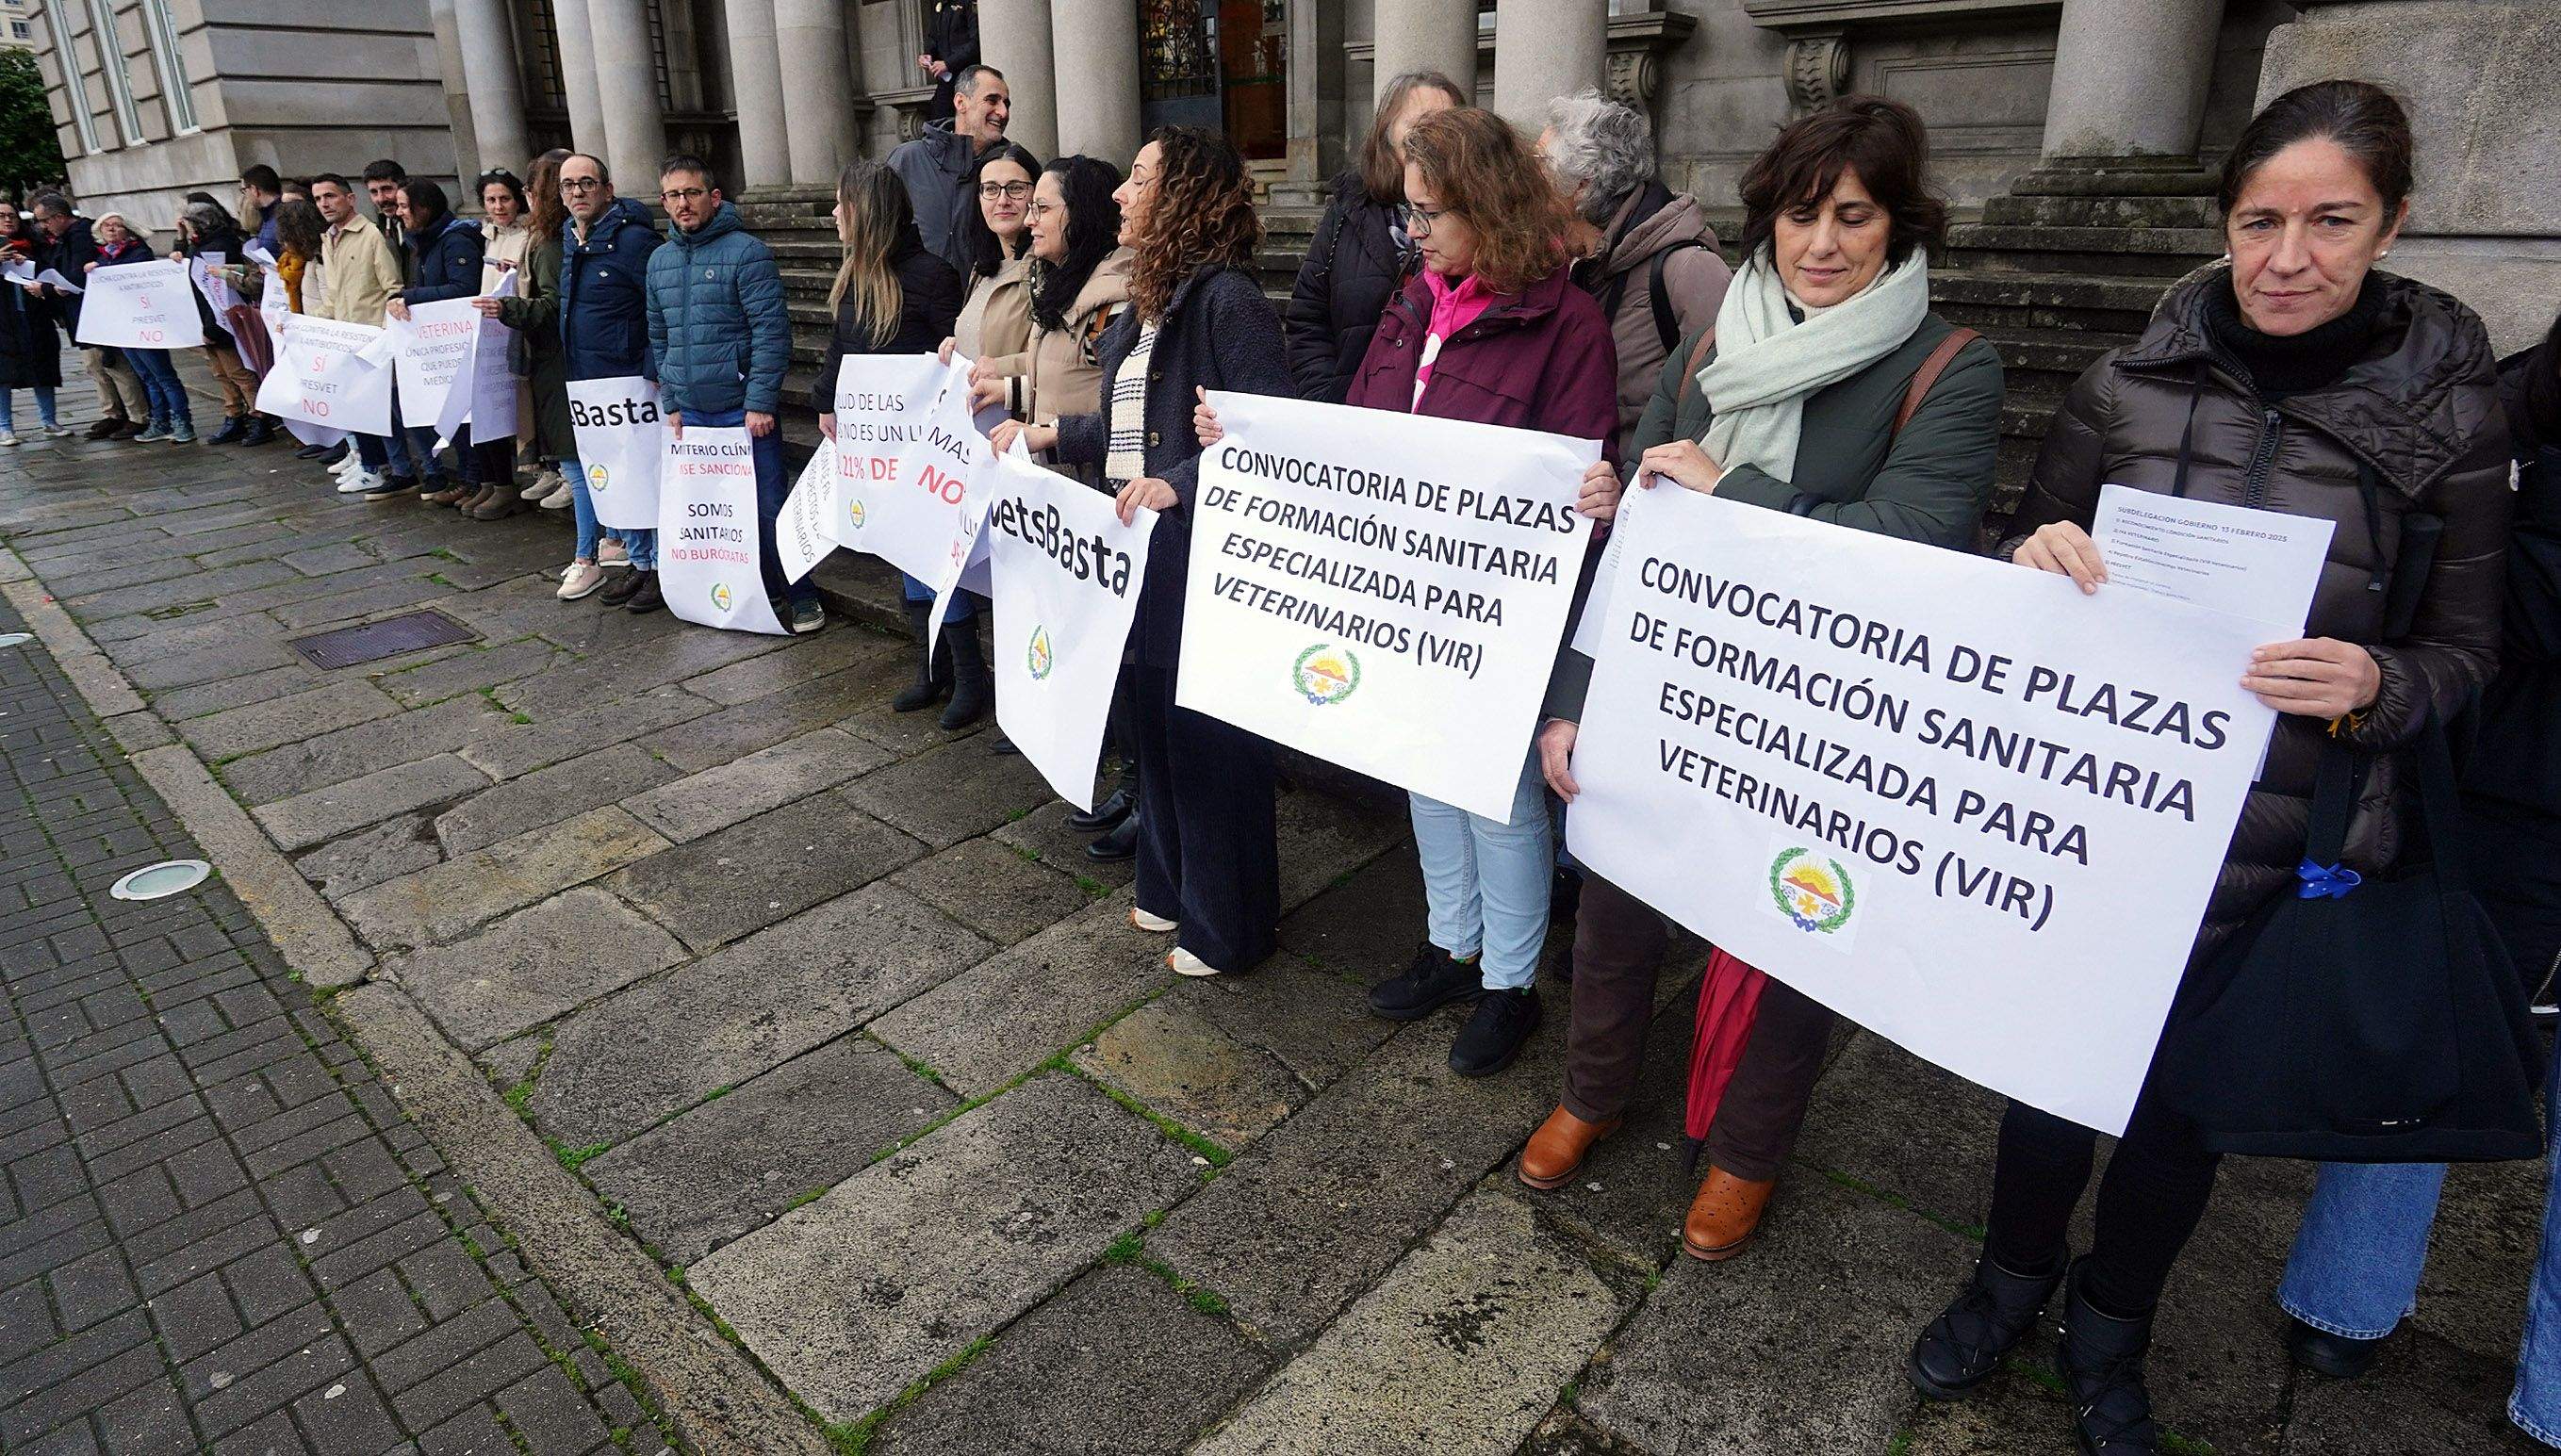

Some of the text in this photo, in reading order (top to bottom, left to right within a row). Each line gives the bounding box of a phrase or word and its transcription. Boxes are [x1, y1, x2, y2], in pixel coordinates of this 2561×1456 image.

[140, 330, 164, 342] NO
[303, 399, 329, 417] NO
[859, 393, 873, 411] DE
[878, 394, 904, 412] LAS
[861, 424, 874, 441] ES
[878, 425, 903, 442] UN
[843, 455, 865, 480] 21%
[870, 457, 899, 481] DE
[917, 465, 966, 506] NO
[1223, 448, 1405, 505] CONVOCATORIA
[1416, 482, 1450, 512] DE
[1457, 489, 1576, 533] PLAZAS
[688, 503, 733, 517] SOMOS
[680, 526, 743, 543] SANITARIOS
[1205, 486, 1556, 584] DE FORMACIÓN SANITARIA
[2177, 517, 2218, 532] GOBIERNO
[2222, 525, 2230, 533] 13
[2231, 527, 2267, 540] FEBRERO
[2267, 532, 2289, 543] 2025
[671, 548, 687, 560] NO
[1222, 530, 1501, 626] ESPECIALIZADA PARA
[1215, 573, 1482, 679] VETERINARIOS (VIR)
[1642, 557, 2230, 749] CONVOCATORIA DE PLAZAS
[1631, 612, 2193, 824] DE FORMACIÓN SANITARIA
[1660, 679, 2087, 865] ESPECIALIZADA PARA
[1661, 738, 2052, 931] VETERINARIOS (VIR)
